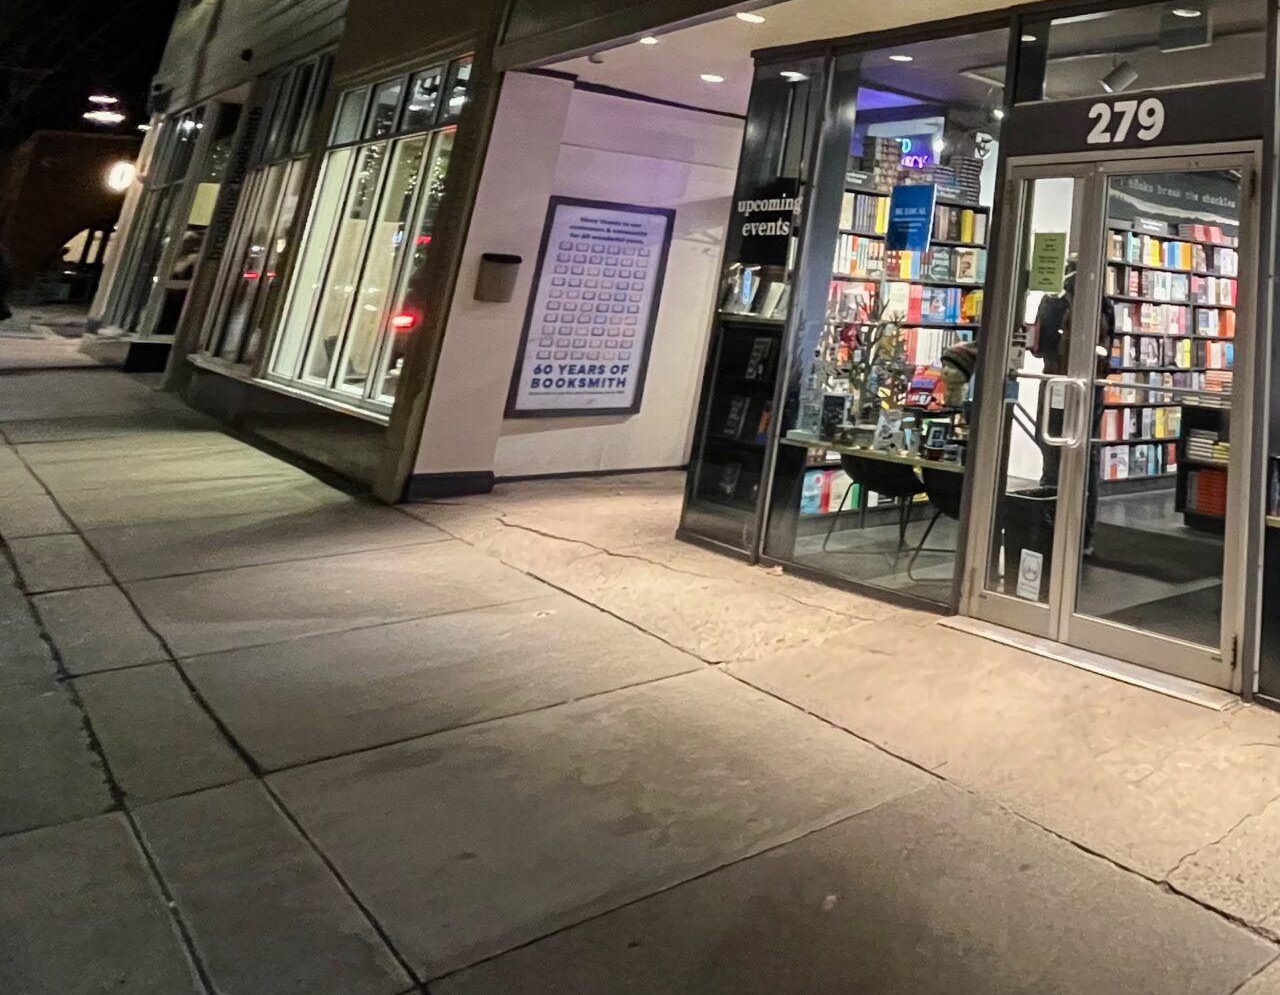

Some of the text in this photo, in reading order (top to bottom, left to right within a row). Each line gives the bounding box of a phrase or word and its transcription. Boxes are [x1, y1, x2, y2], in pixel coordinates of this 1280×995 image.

[1087, 98, 1165, 144] 279
[738, 193, 803, 217] upcoming
[742, 217, 790, 237] events
[533, 364, 630, 375] 60 YEARS OF
[530, 377, 627, 389] BOOKSMITH
